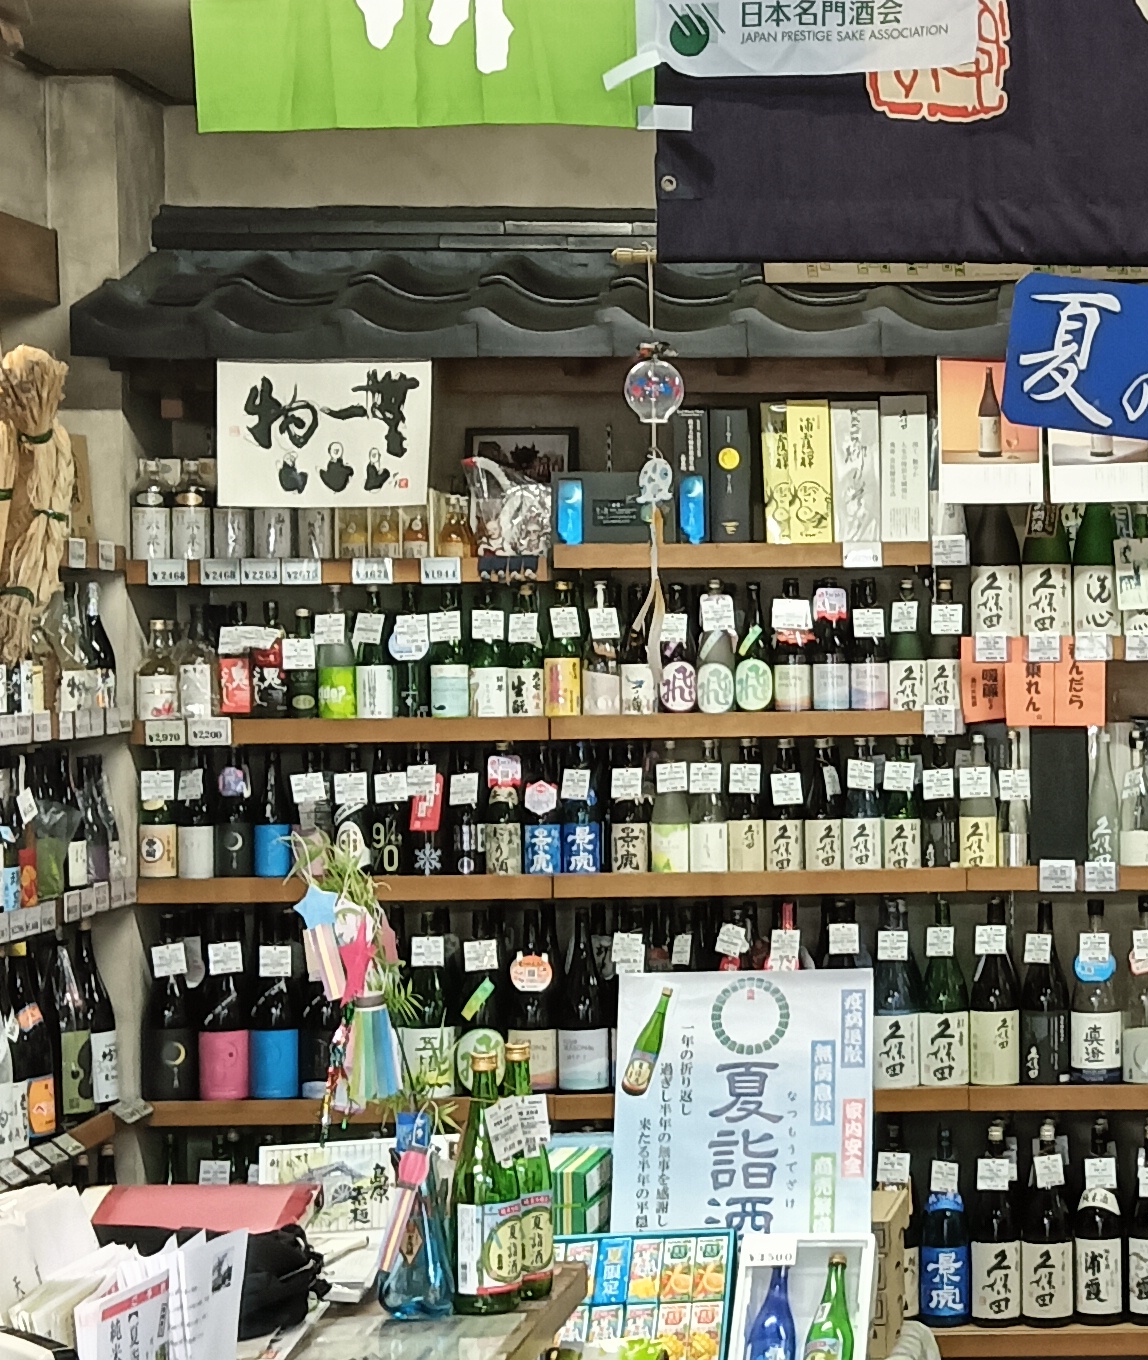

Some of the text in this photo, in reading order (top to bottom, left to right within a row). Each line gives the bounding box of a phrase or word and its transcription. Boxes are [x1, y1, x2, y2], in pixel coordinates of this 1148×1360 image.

[740, 24, 949, 44] JAPAN PRESTIGE SAKE ASSOCIATION
[1028, 567, 1057, 631] 久保田
[923, 1017, 957, 1081] 久保田
[635, 1117, 652, 1232] 来たる半年の平穏
[703, 1061, 785, 1234] 夏詣酒
[926, 1250, 964, 1311] 景虎
[981, 1248, 1012, 1314] 久保田
[1029, 1248, 1057, 1309] 久保田
